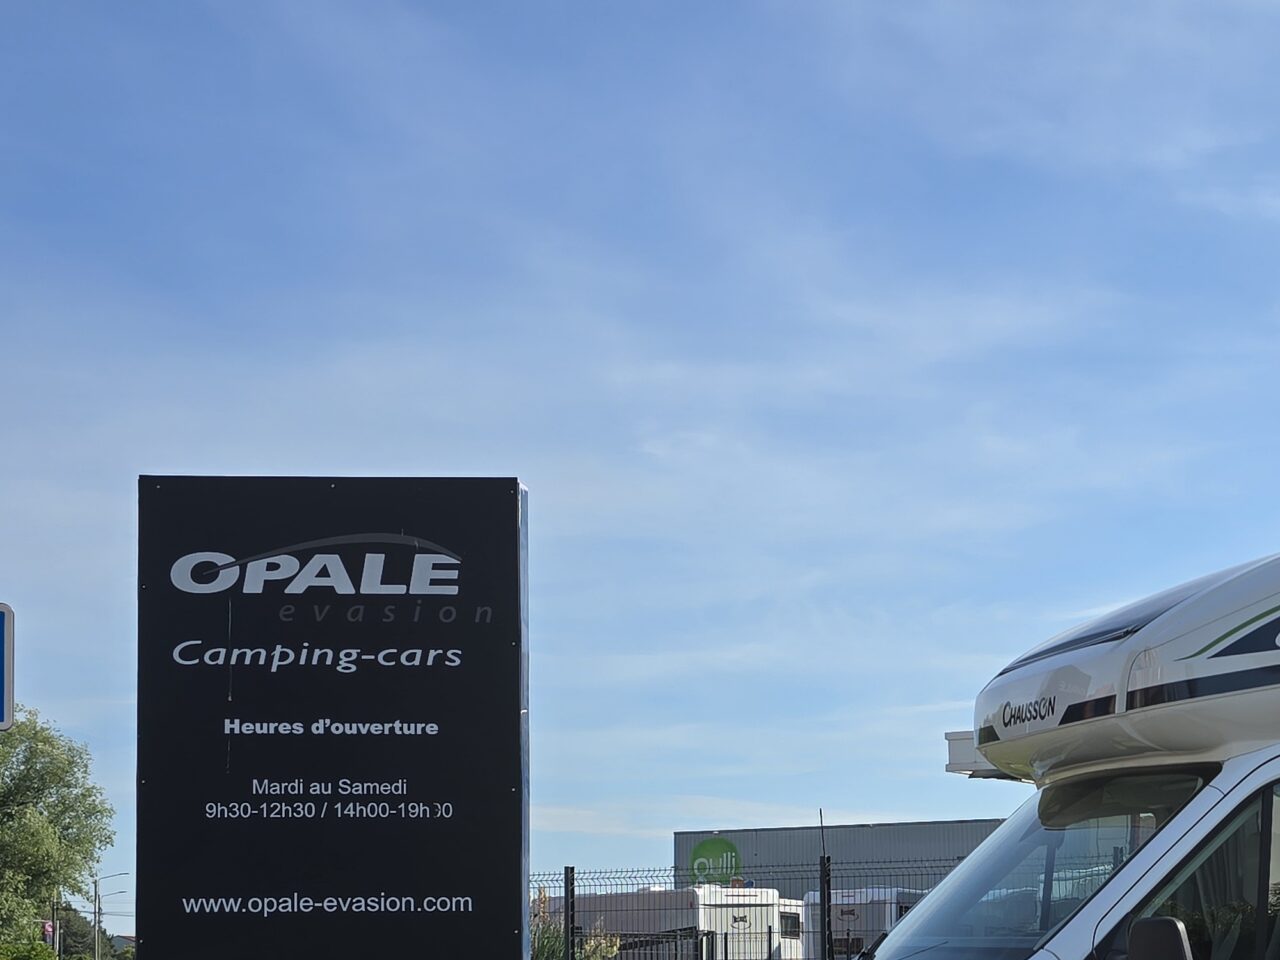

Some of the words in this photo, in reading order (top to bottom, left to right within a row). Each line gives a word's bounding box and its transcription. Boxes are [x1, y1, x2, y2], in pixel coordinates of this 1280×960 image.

[169, 551, 462, 595] OPALE
[278, 600, 493, 623] evasion
[172, 641, 463, 673] Camping-cars
[224, 719, 305, 735] Heures
[310, 719, 439, 735] d'ouverture
[252, 779, 304, 795] Mardi
[309, 783, 332, 795] au
[337, 779, 407, 795] Samedi
[205, 803, 316, 819] 9h30-12h30
[181, 892, 473, 917] www.opale-evasion.com
